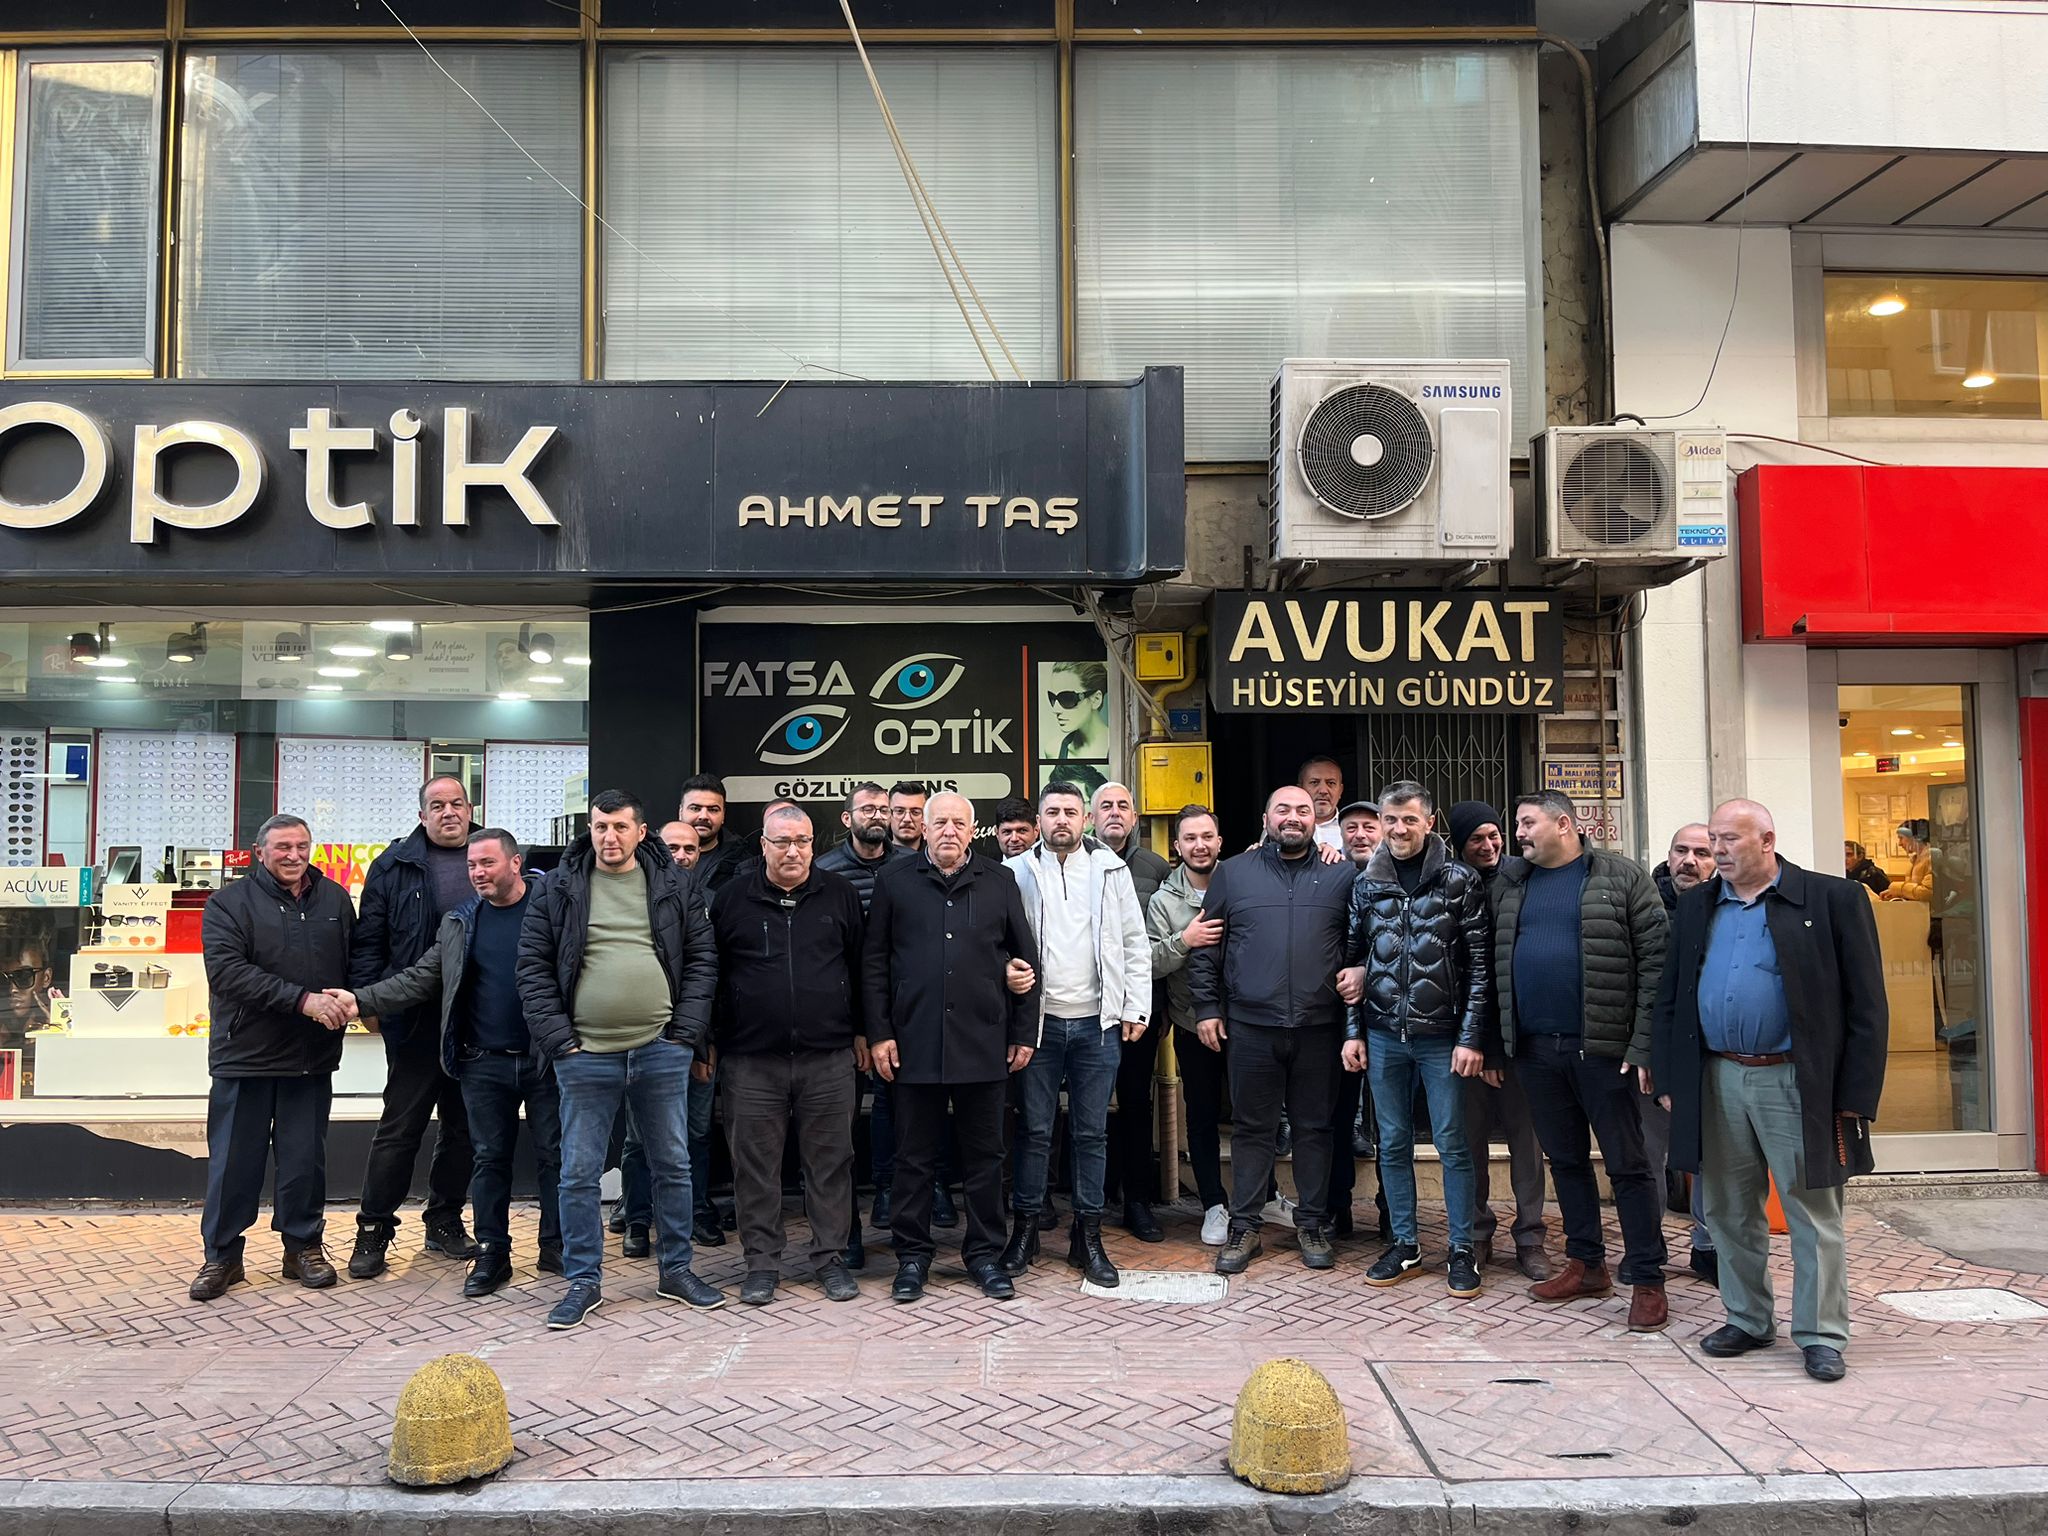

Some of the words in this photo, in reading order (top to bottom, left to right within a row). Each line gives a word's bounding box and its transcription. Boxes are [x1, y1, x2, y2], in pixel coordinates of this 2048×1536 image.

[1422, 385, 1501, 399] SAMSUNG
[1686, 445, 1721, 456] Midea
[0, 401, 561, 545] Optik
[738, 495, 944, 528] AHMET
[965, 496, 1079, 535] TAŞ
[1679, 526, 1726, 536] TEKNOSA
[1228, 600, 1550, 662] AVUKAT
[703, 659, 856, 697] FATSA
[1232, 670, 1385, 707] HÜSEYİN
[1397, 670, 1554, 707] GÜNDÜZ
[1574, 694, 1610, 703] ALTUNSY
[1181, 713, 1189, 725] 9
[873, 708, 1014, 754] OPTİK
[774, 778, 873, 797] GÖZLÜ
[897, 780, 958, 797] NS
[1581, 780, 1617, 789] KARUZ
[4, 880, 69, 893] ACUVUE
